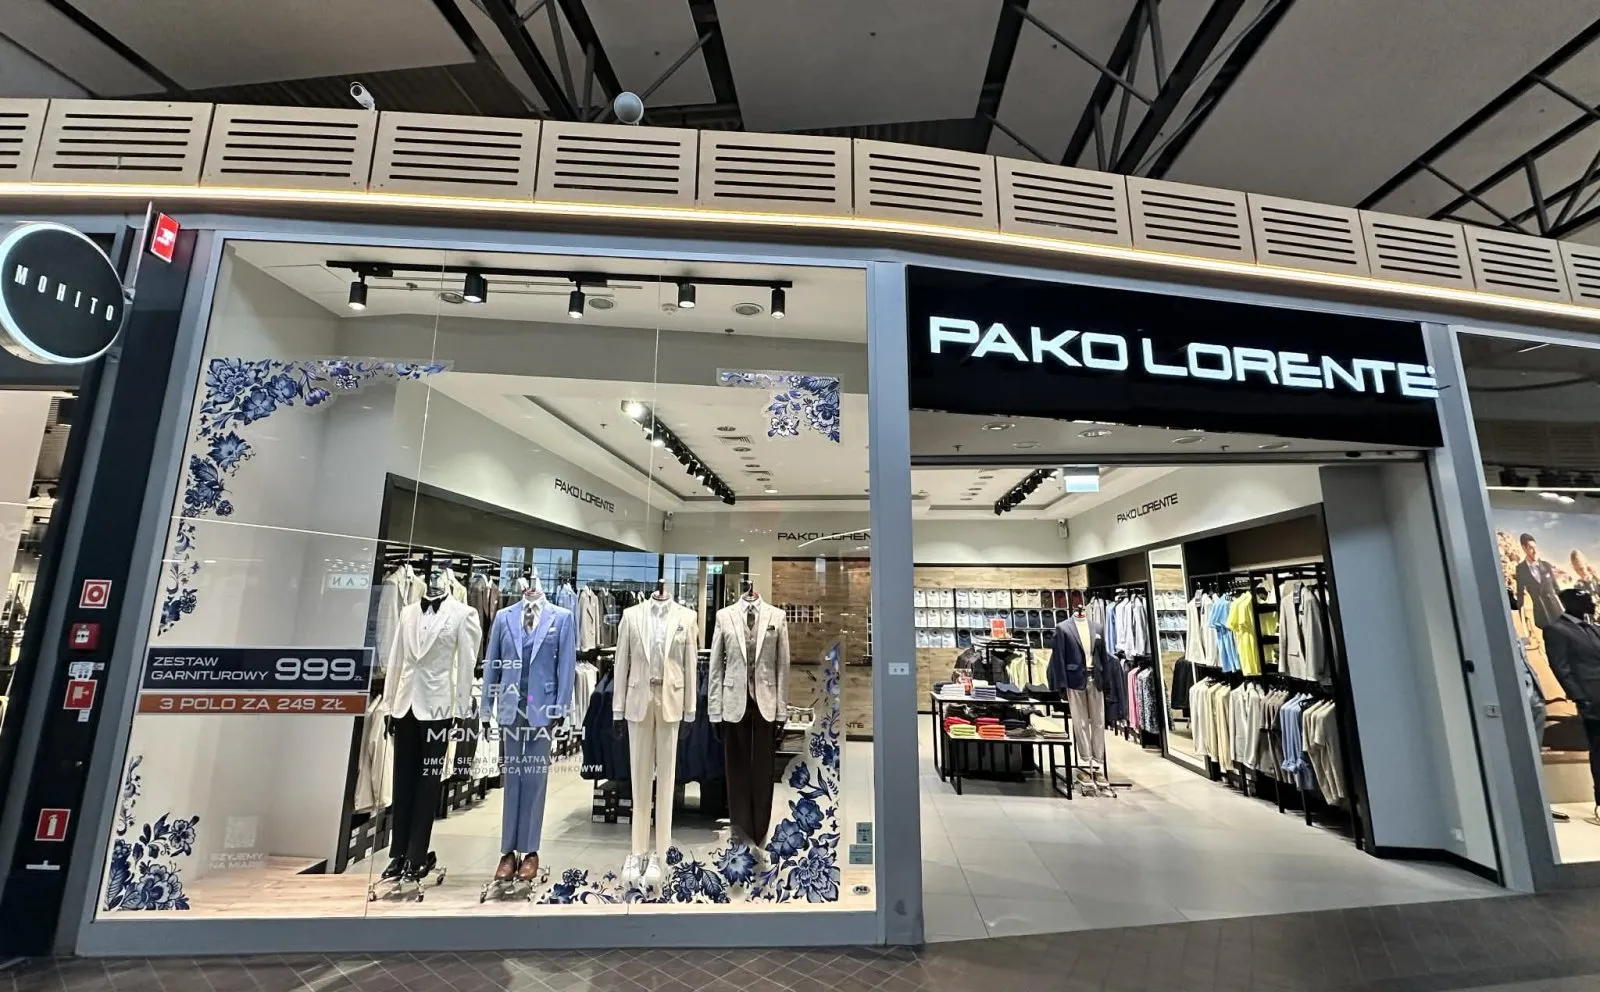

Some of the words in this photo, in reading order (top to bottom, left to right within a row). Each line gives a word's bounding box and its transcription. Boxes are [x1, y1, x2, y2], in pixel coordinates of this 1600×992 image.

[14, 264, 114, 321] MOHITO
[929, 316, 1128, 371] PAKO
[1142, 337, 1440, 398] LORENTE
[554, 478, 580, 498] PAKO
[580, 489, 615, 513] LORENTE
[1117, 508, 1137, 523] PAKO
[1137, 493, 1179, 517] LORENTE
[777, 532, 819, 541] PAKO
[153, 656, 219, 667] ZESTAW
[481, 659, 523, 669] 2026
[151, 670, 269, 681] GARNITUROWY
[274, 657, 356, 681] 999
[159, 698, 173, 710] 3
[180, 698, 237, 710] POLO
[241, 698, 270, 710] ZA
[276, 698, 315, 710] 249
[321, 697, 347, 711] ZŁ
[426, 726, 586, 742] MOMENTACH
[491, 755, 547, 765] BEZPŁATNĄ
[422, 768, 429, 776] Z
